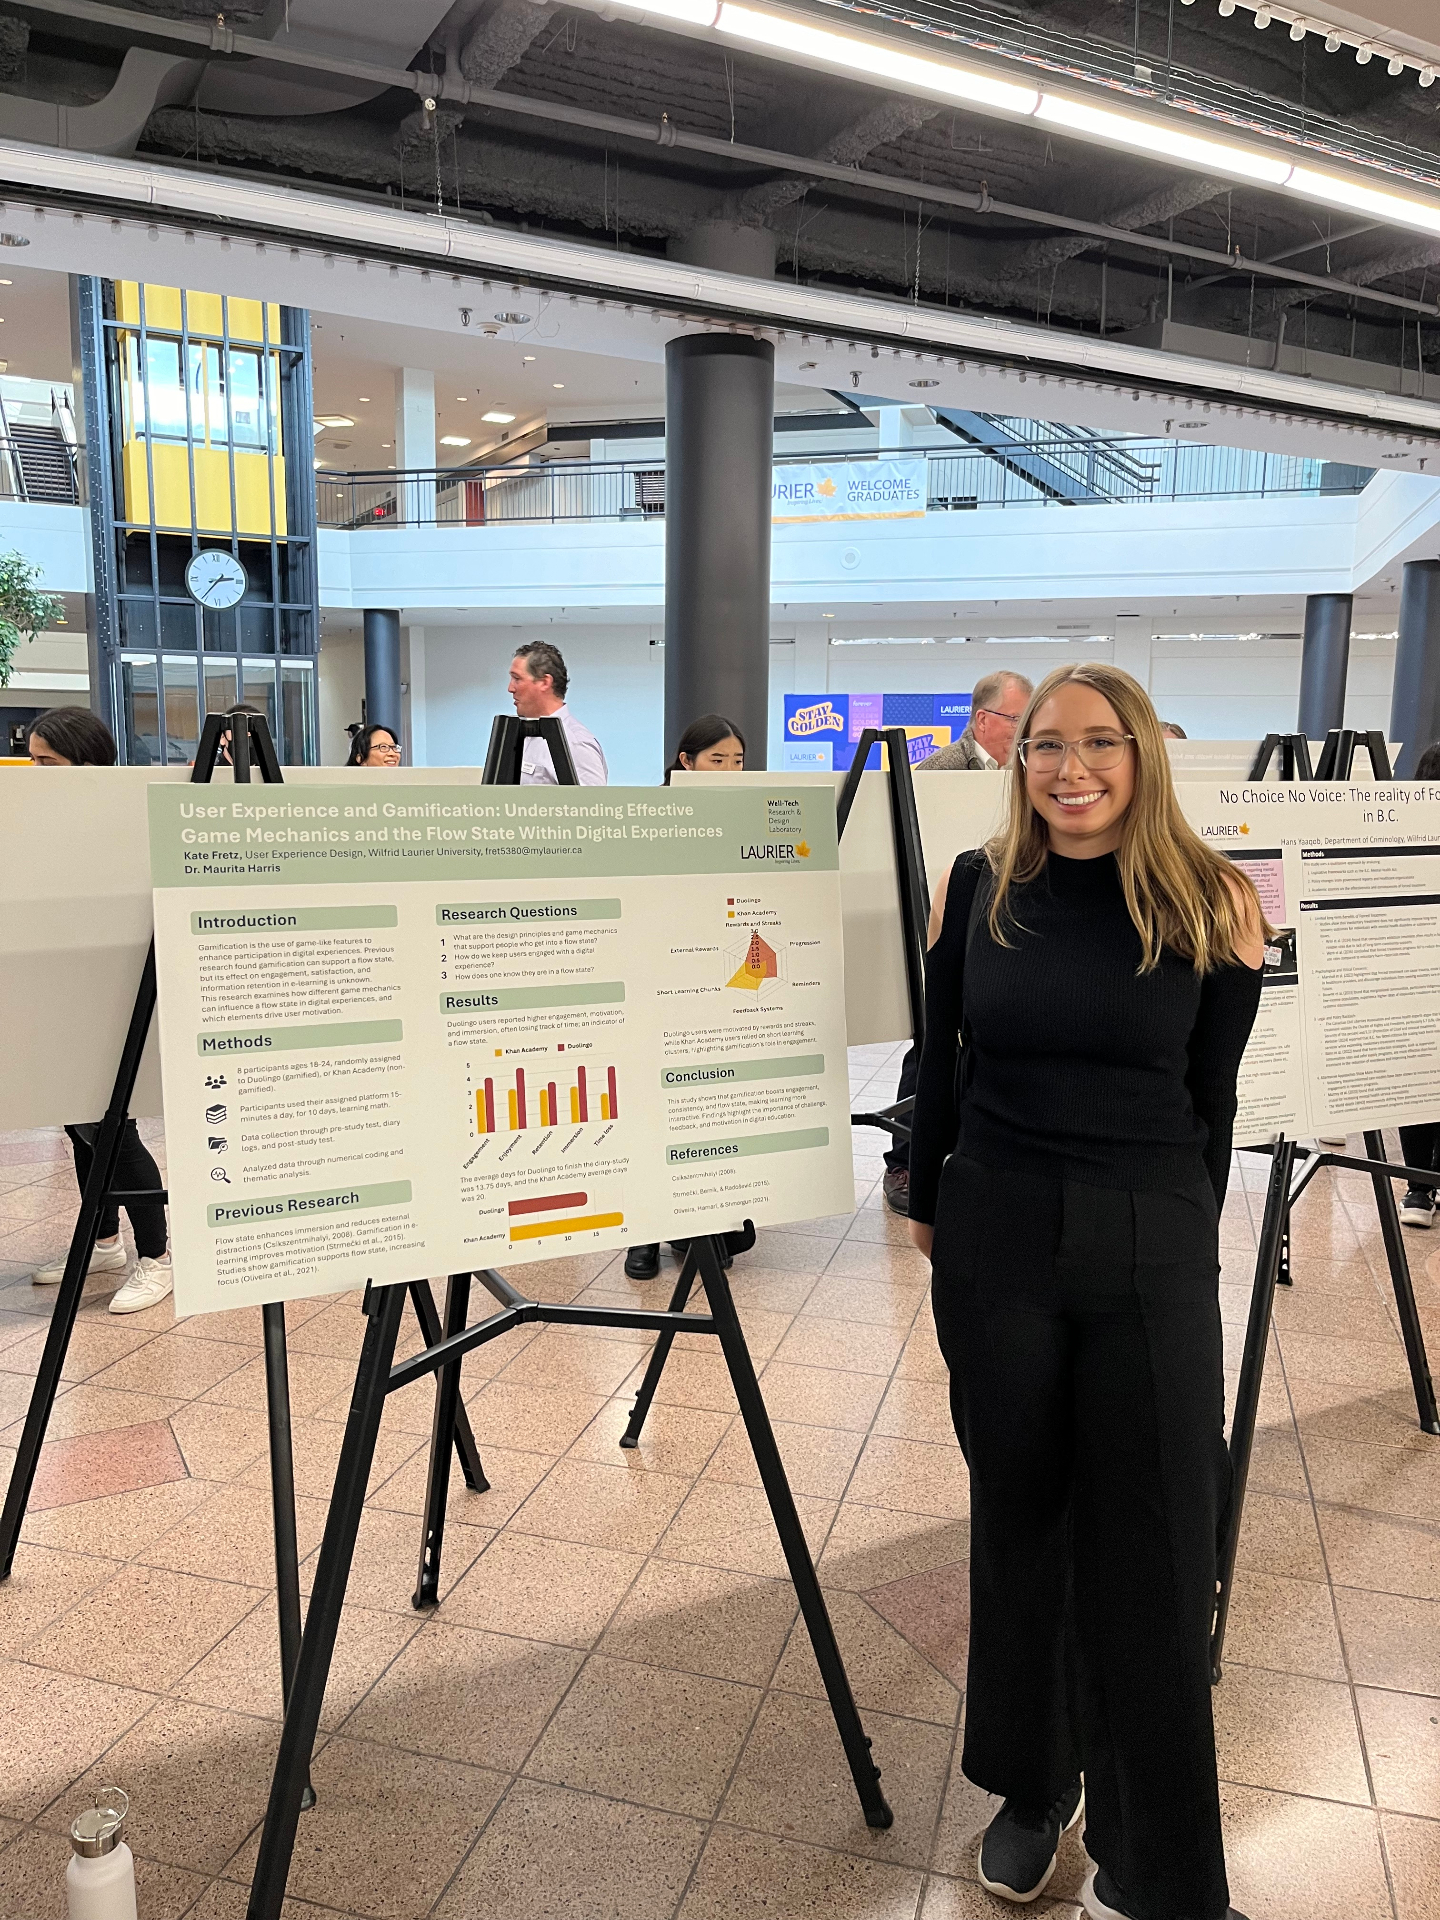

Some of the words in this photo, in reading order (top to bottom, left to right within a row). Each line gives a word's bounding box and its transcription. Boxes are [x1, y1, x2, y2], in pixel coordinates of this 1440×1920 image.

[847, 478, 911, 491] WELCOME
[847, 490, 920, 502] GRADUATES
[798, 704, 830, 722] STAY
[791, 716, 841, 733] GOLDEN
[907, 736, 932, 752] TAY
[1220, 790, 1239, 804] No
[1242, 789, 1284, 803] Choice
[1288, 789, 1306, 803] No
[1308, 788, 1346, 803] Voice:
[1348, 788, 1371, 802] The
[1374, 788, 1410, 805] reality
[1414, 787, 1425, 801] of
[180, 803, 227, 818] User
[232, 802, 339, 821] Experience
[344, 802, 378, 817] and
[382, 802, 500, 818] Gamification:
[504, 803, 624, 820] Understanding
[627, 802, 694, 817] Effective
[1363, 809, 1374, 822] in
[1377, 809, 1399, 823] B.C.
[768, 817, 790, 826] Design
[181, 828, 240, 844] Game
[246, 826, 350, 843] Mechanics
[354, 826, 388, 842] and
[392, 826, 422, 841] the
[426, 826, 467, 841] Flow
[471, 826, 515, 840] State
[518, 825, 572, 840] Within
[576, 825, 628, 842] Digital
[631, 824, 723, 842] Experiences
[1201, 825, 1239, 836] LAURIER
[1324, 837, 1362, 846] Department
[1362, 836, 1369, 844] of
[1369, 836, 1406, 844] Criminology,
[1406, 834, 1427, 842] Wilfrid
[184, 851, 209, 860] Kate
[212, 850, 243, 860] Fretz,
[245, 850, 269, 860] User
[271, 849, 327, 860] Experience
[329, 849, 366, 860] Design,
[368, 848, 400, 857] Wilfrid
[402, 848, 435, 857] Laurier
[436, 848, 483, 857] University,
[485, 846, 582, 857] fret5380@mylaurier.ca
[741, 844, 795, 860] LAURIER
[184, 865, 200, 874] Dr.
[203, 864, 245, 874] Maurita
[248, 864, 281, 873] Harris
[442, 907, 506, 920] Research
[510, 905, 578, 920] Questions
[1300, 901, 1319, 911] Results
[198, 913, 296, 929] Introduction
[296, 939, 332, 949] game-like
[440, 938, 445, 946] 1
[441, 954, 447, 962] 2
[441, 971, 448, 980] 3
[446, 994, 498, 1008] Results
[203, 1034, 272, 1051] Methods
[243, 1064, 289, 1075] participants
[334, 1057, 368, 1066] randomly
[369, 1054, 401, 1064] assigned
[247, 1075, 281, 1084] Duolingo
[282, 1071, 322, 1082] (gamified),
[666, 1067, 735, 1083] Conclusion
[238, 1085, 276, 1096] gamified).
[240, 1103, 286, 1112] Participants
[325, 1095, 358, 1105] assigned
[358, 1092, 389, 1102] platform
[240, 1114, 272, 1123] minutes
[339, 1104, 370, 1113] learning
[260, 1130, 299, 1140] collection
[300, 1126, 329, 1136] through
[330, 1123, 365, 1134] pre-study
[594, 1134, 606, 1147] Time
[603, 1124, 614, 1137] loss
[277, 1138, 318, 1149] post-study
[498, 1134, 522, 1162] Enjoyment
[531, 1130, 553, 1155] Retention
[560, 1127, 584, 1154] Immersion
[462, 1138, 490, 1170] Engagement
[670, 1144, 739, 1161] References
[242, 1163, 277, 1173] Analyzed
[297, 1157, 326, 1167] through
[327, 1153, 364, 1163] numerical
[364, 1150, 389, 1159] coding
[243, 1174, 278, 1183] thematic
[279, 1170, 311, 1179] analysis.
[215, 1203, 284, 1221] Previous
[288, 1192, 359, 1212] Research
[478, 1207, 505, 1216] Duolingo
[479, 1233, 506, 1241] Academy
